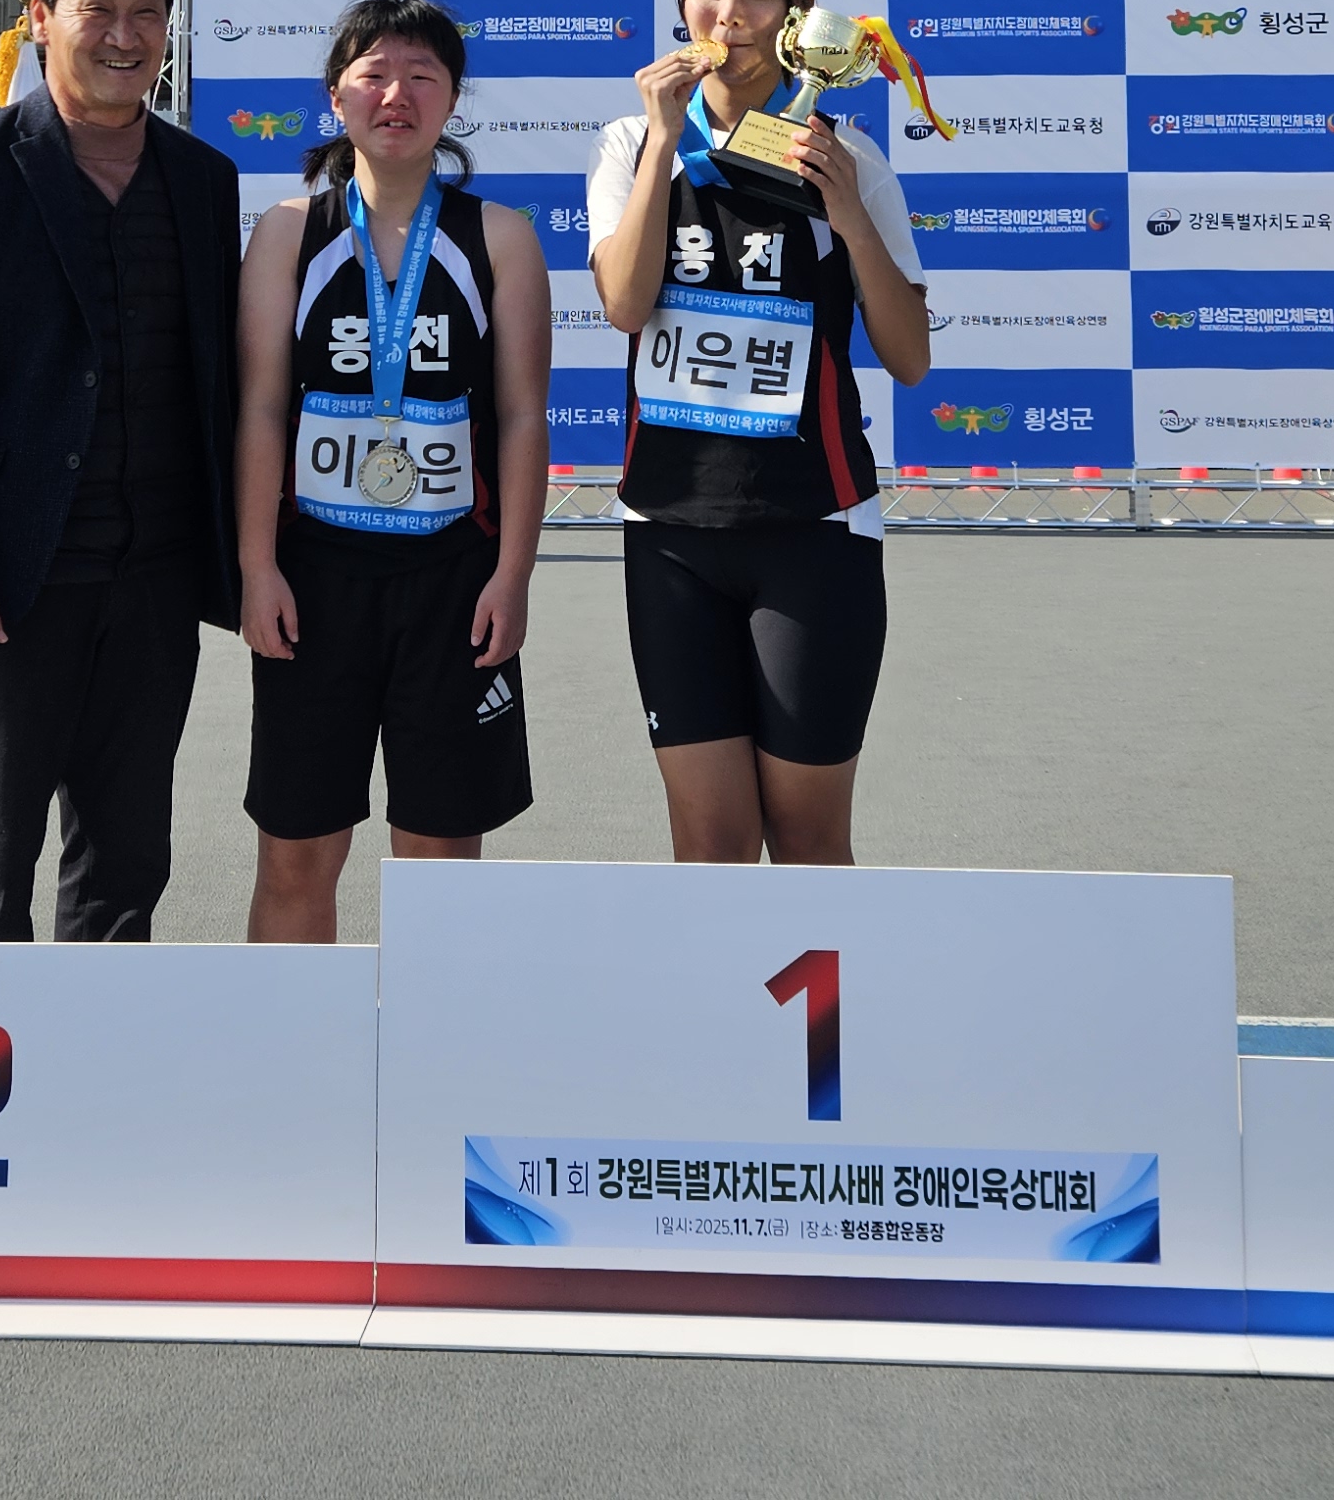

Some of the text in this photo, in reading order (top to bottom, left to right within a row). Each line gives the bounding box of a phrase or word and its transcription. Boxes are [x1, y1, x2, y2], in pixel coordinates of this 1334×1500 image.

[484, 17, 614, 33] 횡성군장애인체육회
[940, 17, 1082, 31] 강원특별자치도장애인체육회
[1259, 12, 1329, 35] 횡성군
[528, 33, 546, 41] PARA
[547, 33, 571, 41] SPORTS
[572, 33, 613, 41] ASSOCIATION
[1041, 29, 1083, 37] ASSOCIATION
[1182, 114, 1327, 128] 강원특별자치도장애인체육회
[1284, 127, 1327, 135] ASSOCIATION
[549, 208, 589, 231] 횡성
[953, 208, 1087, 225] 횡성군장애인체육회
[999, 225, 1017, 233] PARA
[1018, 225, 1044, 233] SPORTS
[1045, 225, 1087, 233] ASSOCIATION
[960, 315, 1108, 327] 강원특별자치도장애인육상연맹
[1198, 306, 1334, 325] 횡성군장애인체육회
[1244, 324, 1264, 332] PARA
[1264, 324, 1290, 332] SPORTS
[1290, 324, 1334, 332] ASSOCIATION
[651, 326, 794, 396] 이은별
[1023, 407, 1094, 431] 횡성군
[311, 434, 462, 494] 이은
[765, 950, 843, 1123] 1
[517, 1156, 1097, 1214] 제1회 강원특별자치도지사배 장애인육상대회
[840, 1219, 946, 1242] 횡성종합운동장
